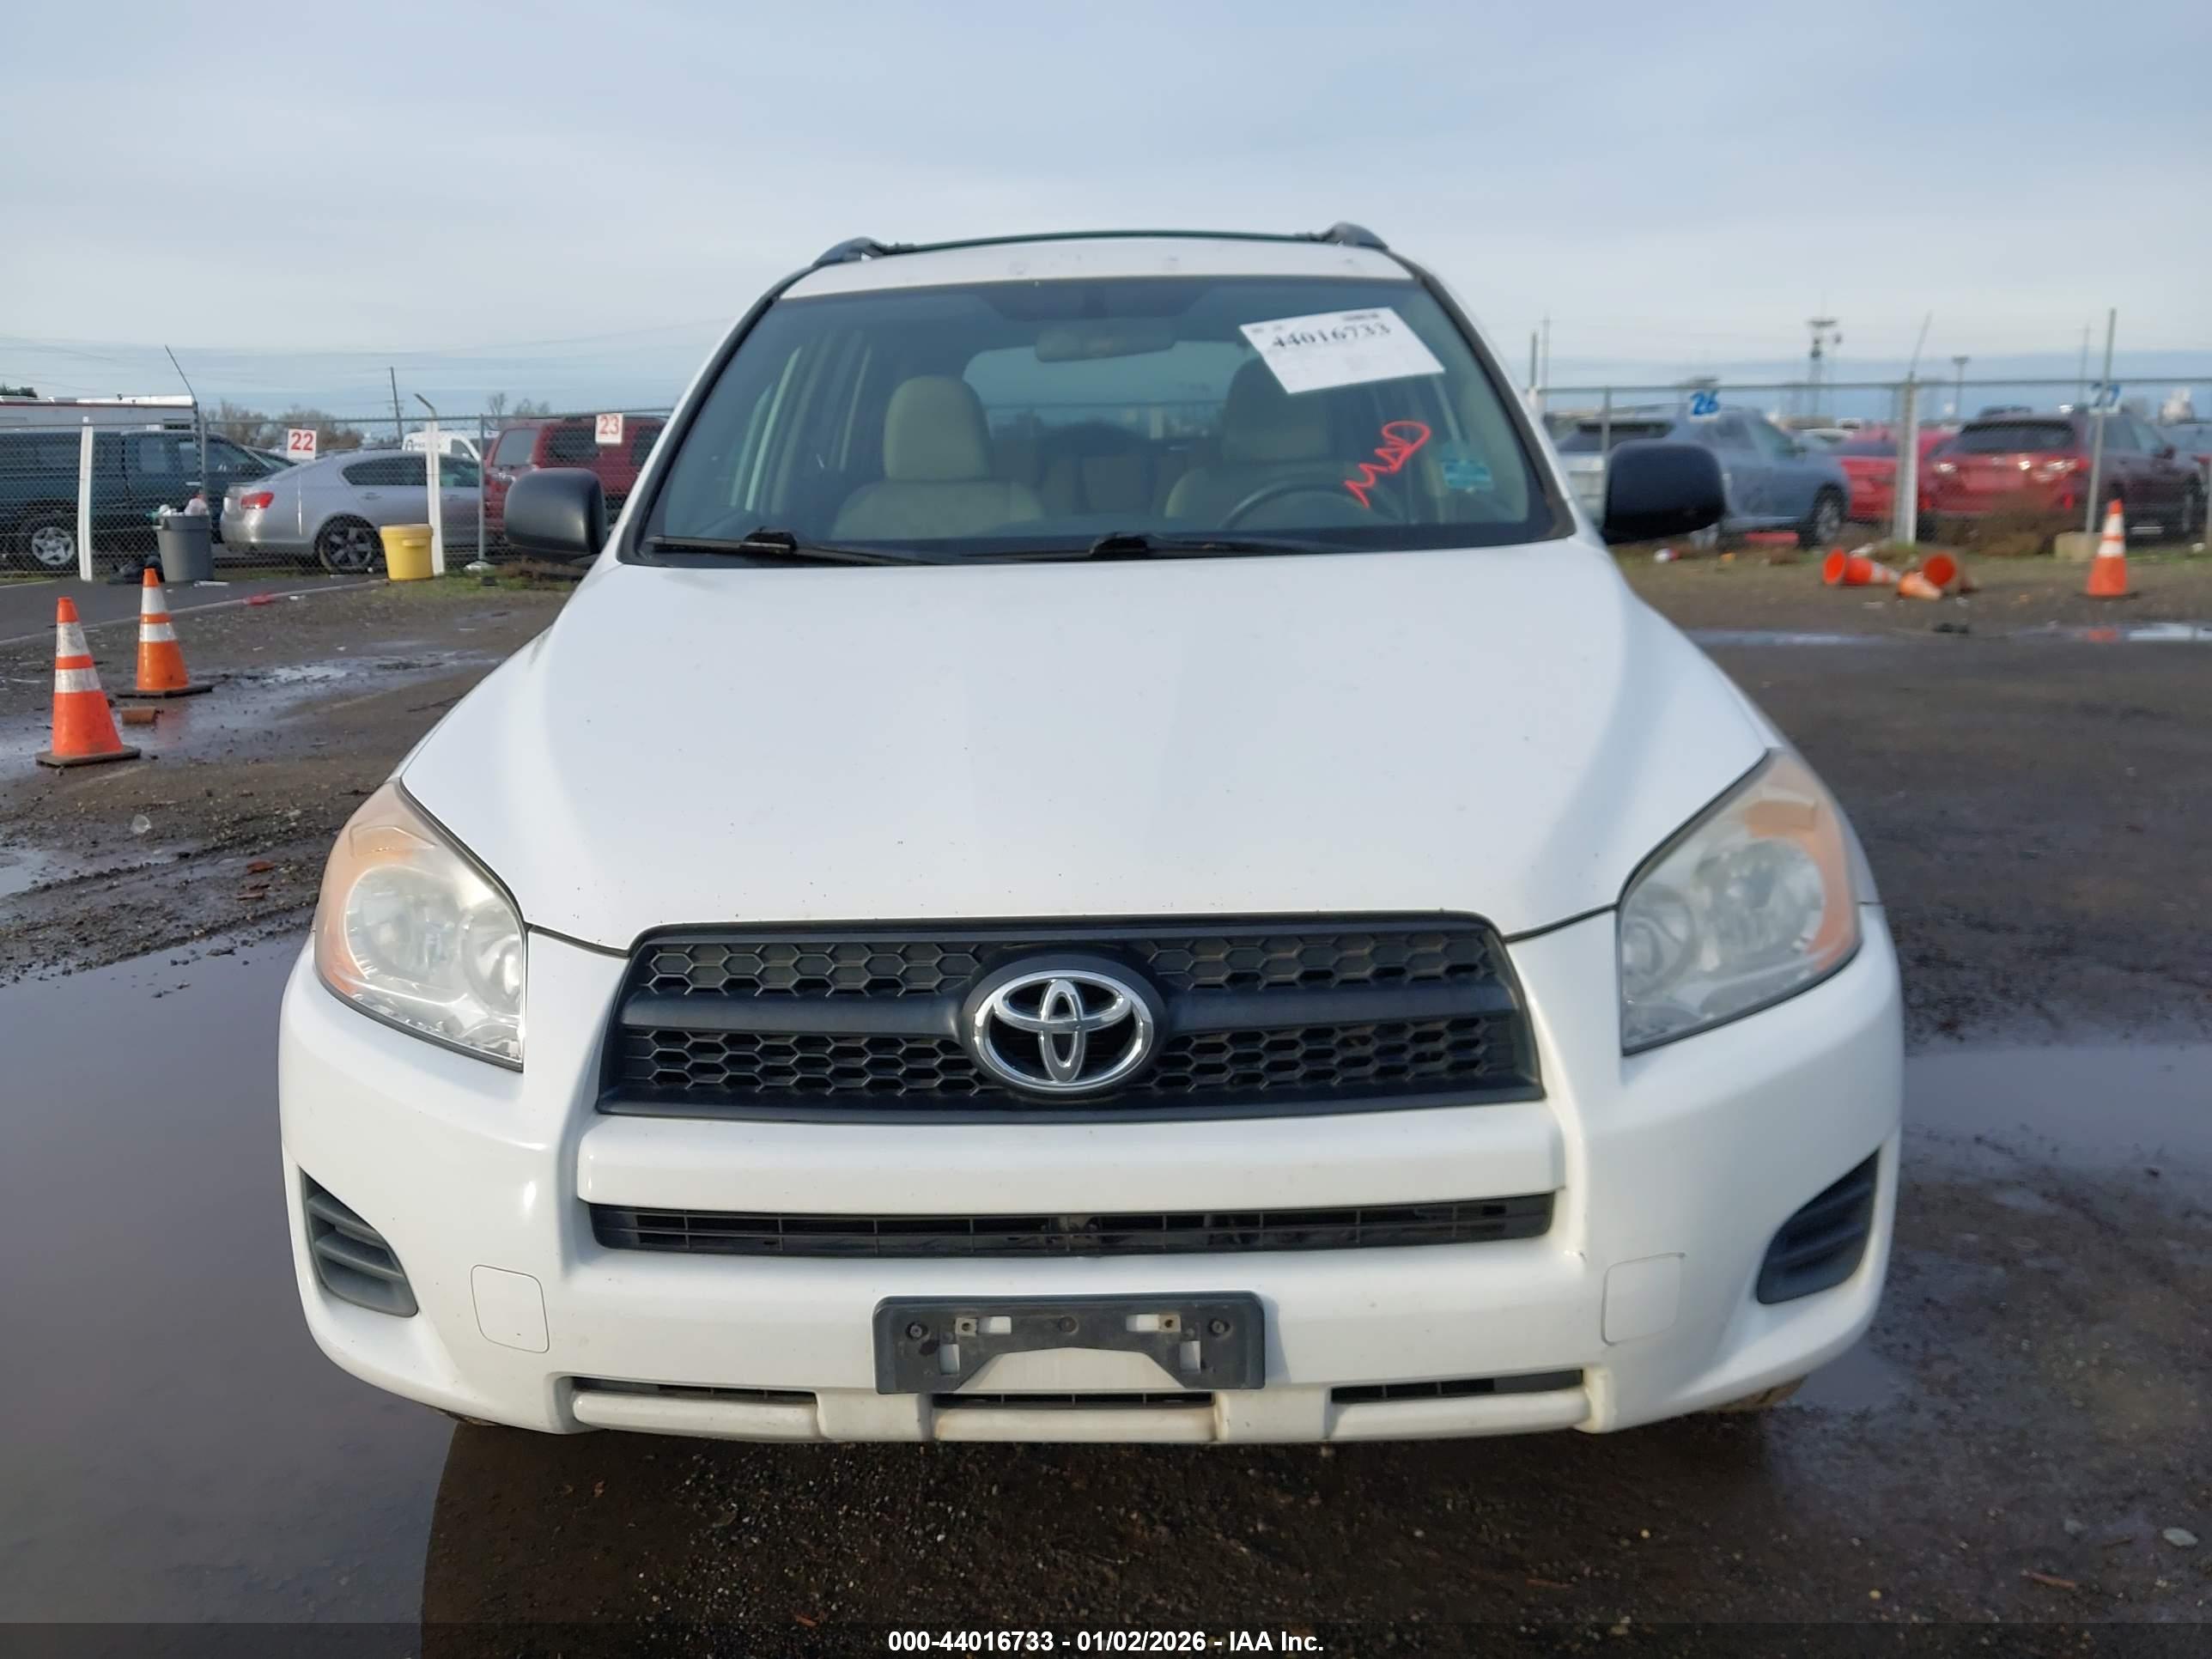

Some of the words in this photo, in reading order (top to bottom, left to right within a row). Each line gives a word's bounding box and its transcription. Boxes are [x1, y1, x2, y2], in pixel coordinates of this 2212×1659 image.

[1689, 389, 1721, 416] 26
[599, 414, 620, 435] 23
[290, 431, 314, 452] 22
